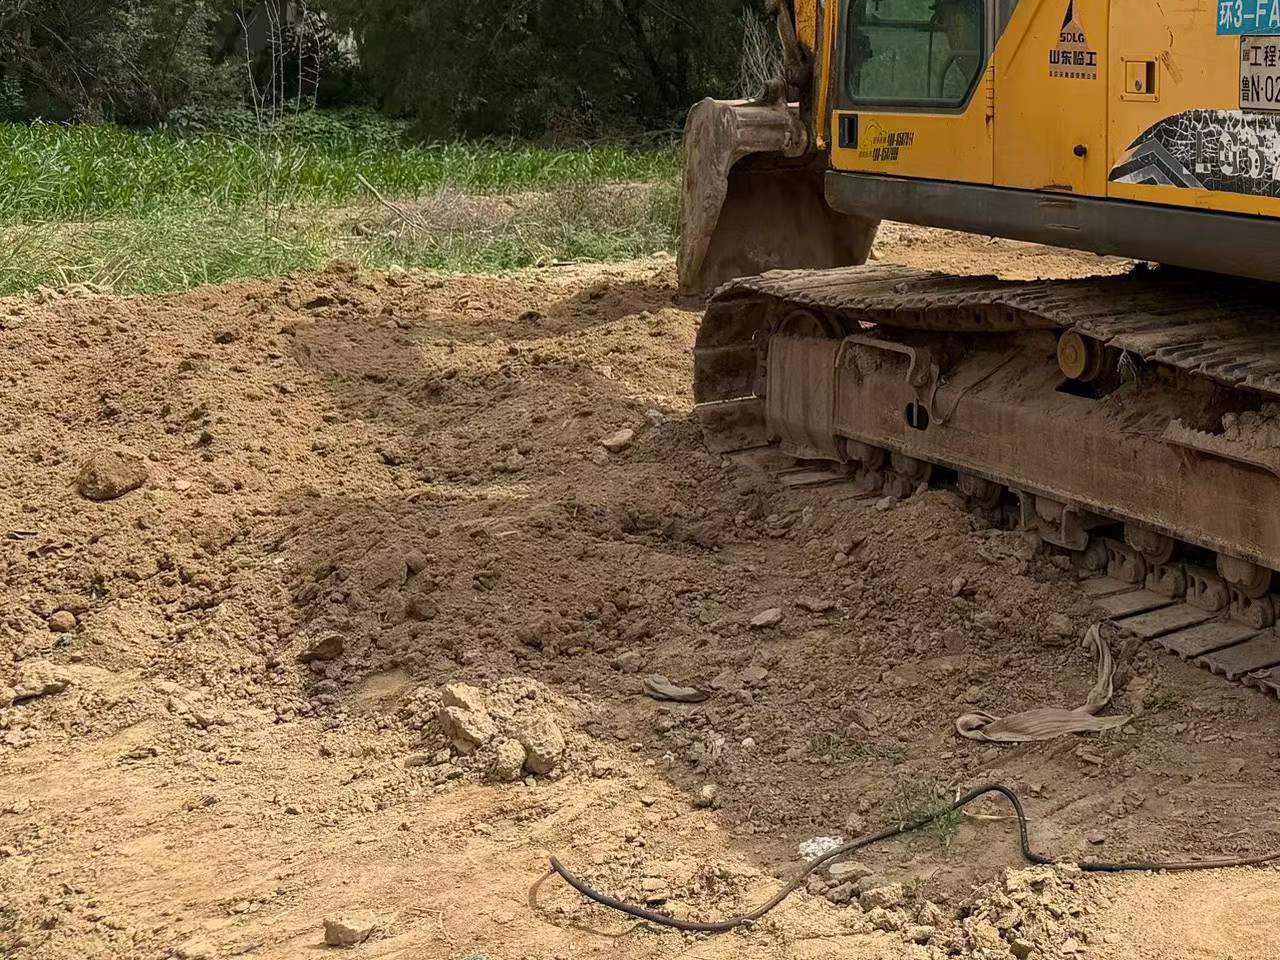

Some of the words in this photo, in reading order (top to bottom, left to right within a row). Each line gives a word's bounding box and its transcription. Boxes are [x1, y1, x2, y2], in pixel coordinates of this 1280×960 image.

[1060, 32, 1085, 43] SDLG
[1049, 49, 1097, 67] 山东临工
